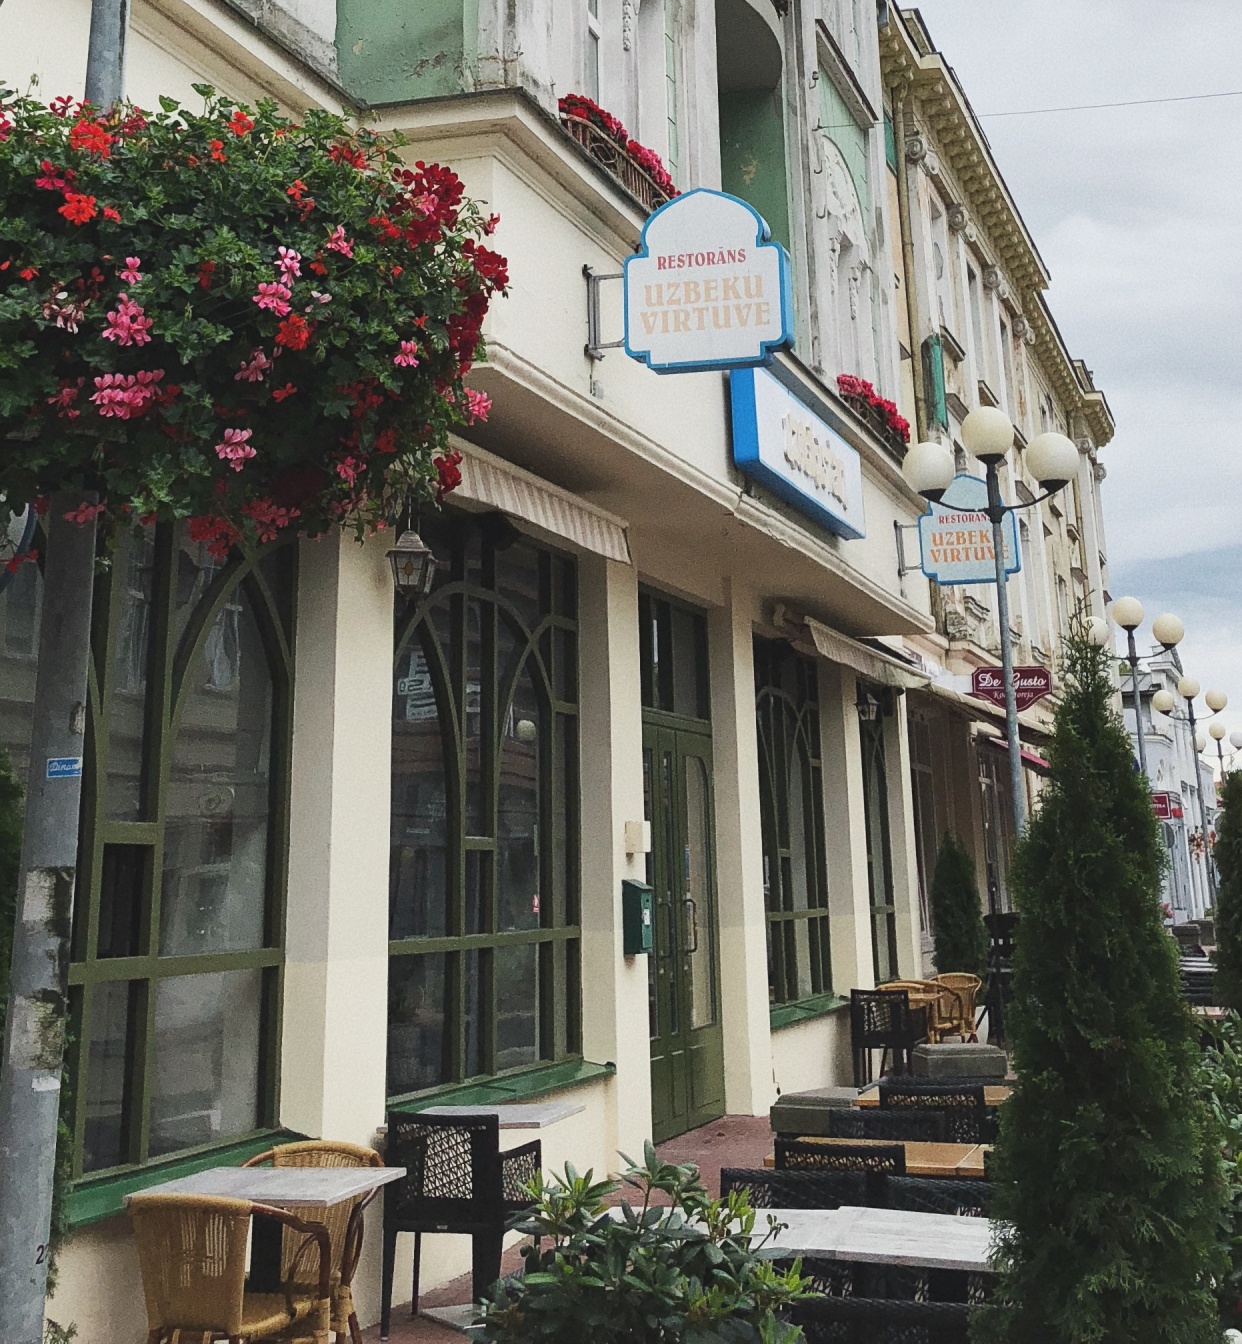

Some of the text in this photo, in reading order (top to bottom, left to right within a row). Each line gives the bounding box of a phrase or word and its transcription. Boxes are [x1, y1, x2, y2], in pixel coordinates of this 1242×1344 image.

[657, 247, 747, 271] RESTORĀNS
[644, 274, 765, 308] UZBEKU
[640, 302, 772, 336] VIRTUVE
[938, 513, 991, 525] RESTORAN
[931, 529, 1004, 547] UZBEK
[978, 672, 1002, 687] De
